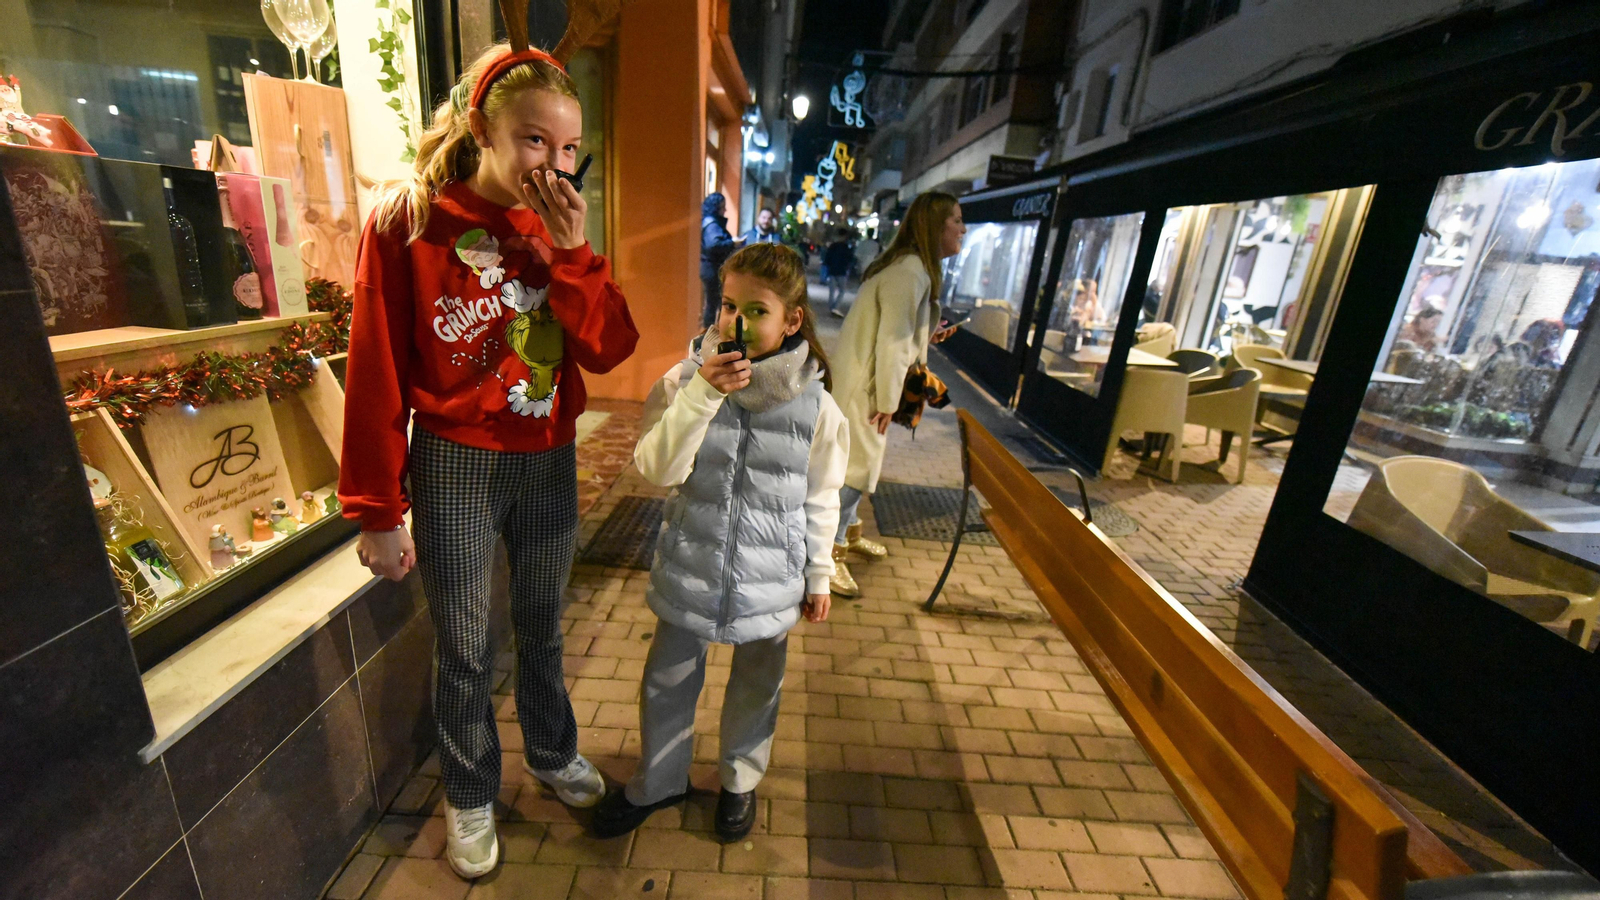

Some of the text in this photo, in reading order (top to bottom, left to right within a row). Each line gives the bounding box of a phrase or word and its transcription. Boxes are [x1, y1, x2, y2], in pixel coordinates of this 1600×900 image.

[434, 295, 464, 313] The
[433, 295, 502, 343] GRINCH
[183, 489, 238, 514] Alambique
